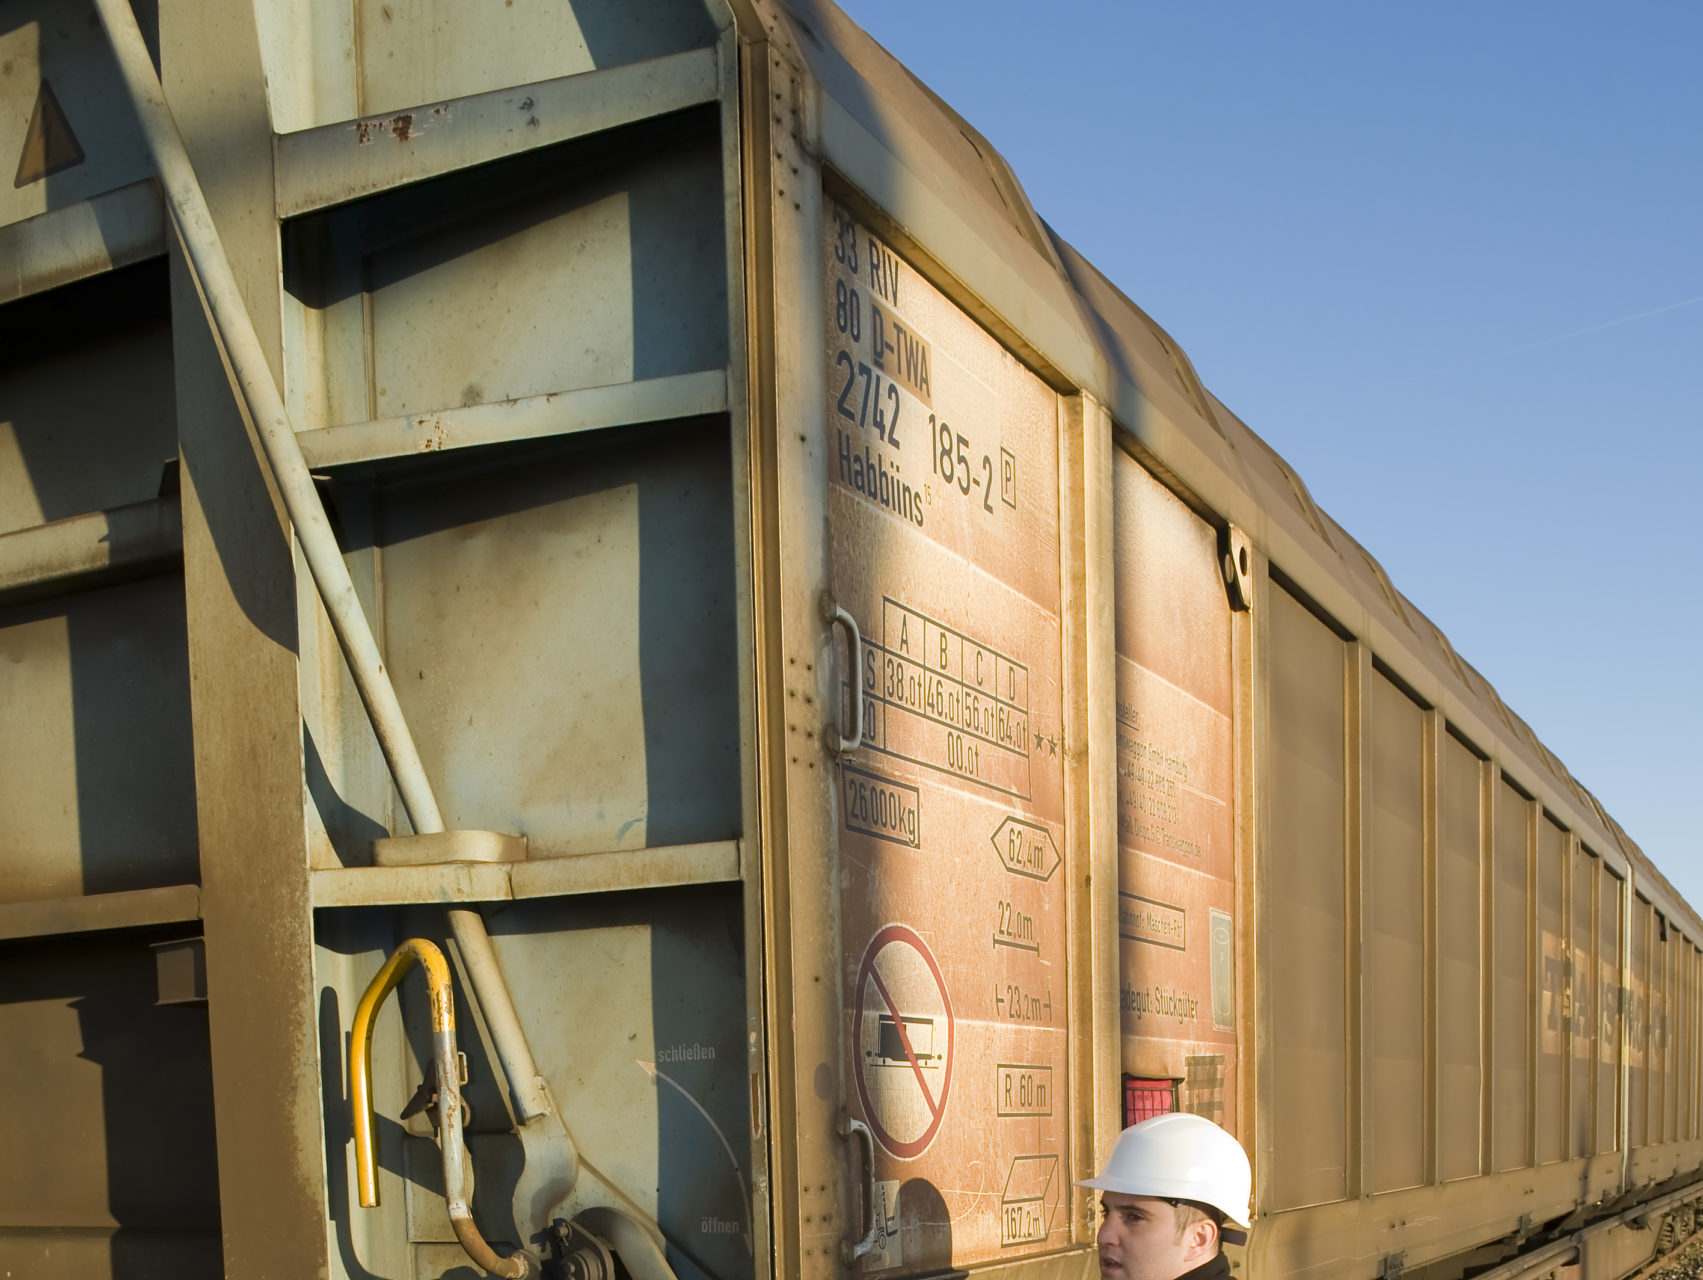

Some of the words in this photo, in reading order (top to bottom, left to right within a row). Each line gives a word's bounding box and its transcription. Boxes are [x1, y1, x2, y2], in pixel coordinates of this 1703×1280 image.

[833, 211, 860, 275] 33
[869, 238, 900, 308] RIV
[836, 279, 861, 343] 80
[873, 304, 931, 398] D-TWA
[836, 350, 900, 451] 2742
[928, 413, 994, 515] 185-2
[837, 428, 924, 527] Habbiins
[1004, 460, 1012, 495] P
[866, 649, 876, 691] S
[899, 613, 910, 653] A
[939, 632, 948, 670] B
[976, 650, 984, 687] C
[1008, 666, 1016, 701] D
[1121, 982, 1154, 1019] adegut:
[1154, 985, 1199, 1025] Stückgüter
[658, 1042, 716, 1063] schließen
[1005, 1073, 1013, 1108] R
[1019, 1073, 1034, 1108] 60
[1036, 1082, 1047, 1108] m
[701, 1217, 739, 1234] öffnen
